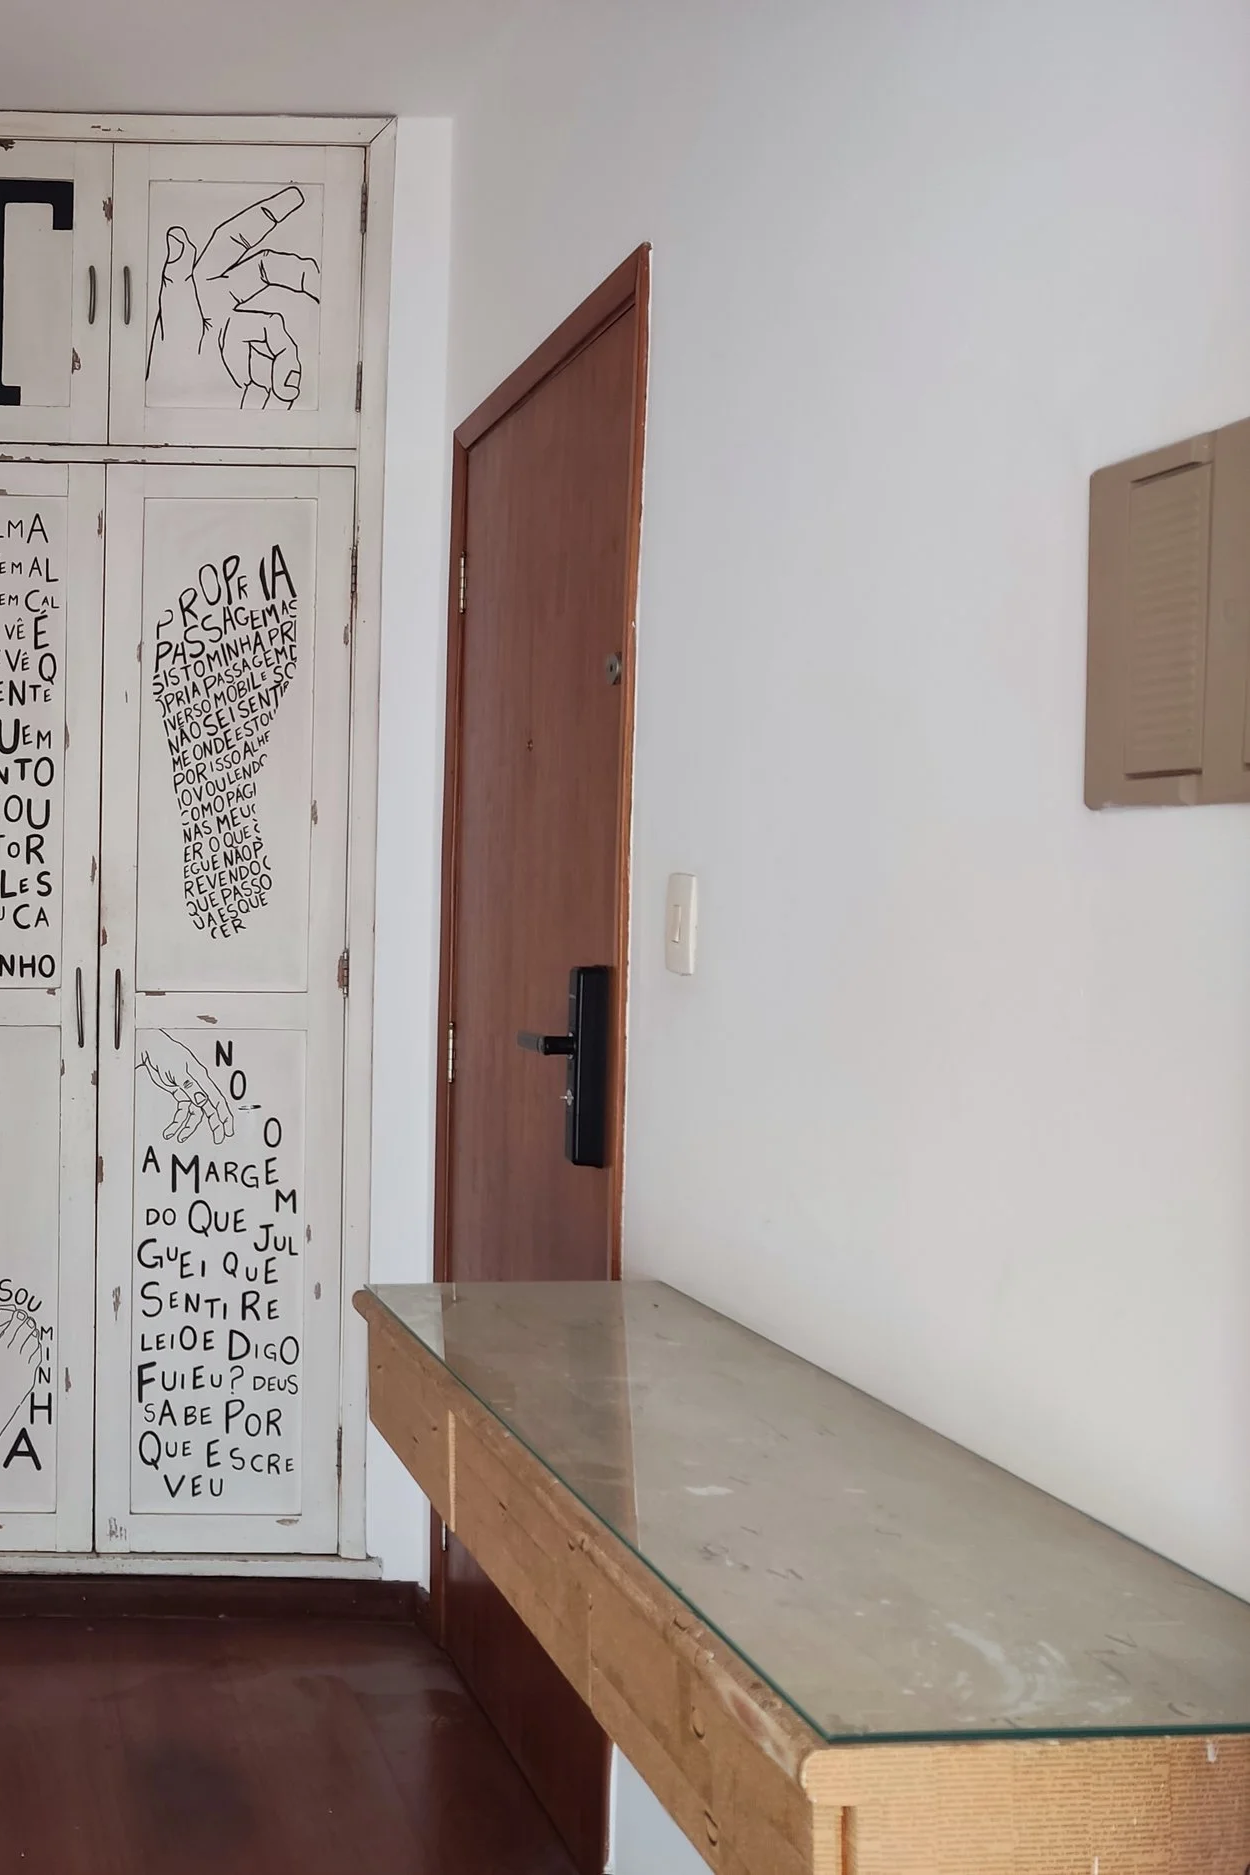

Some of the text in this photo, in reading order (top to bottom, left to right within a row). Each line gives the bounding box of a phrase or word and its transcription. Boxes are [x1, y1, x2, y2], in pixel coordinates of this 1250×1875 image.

[28, 556, 59, 582] AL
[24, 589, 60, 612] CAL
[12, 904, 50, 929] CA
[146, 1208, 177, 1226] DO
[188, 1199, 247, 1237] QUE
[223, 1251, 279, 1285] QUE
[228, 1329, 300, 1365] DIGO
[252, 1374, 299, 1396] DEUS
[143, 1399, 283, 1437] SABE POR
[138, 1430, 295, 1475] QUE ESCRE
[163, 1474, 224, 1498] VEU
